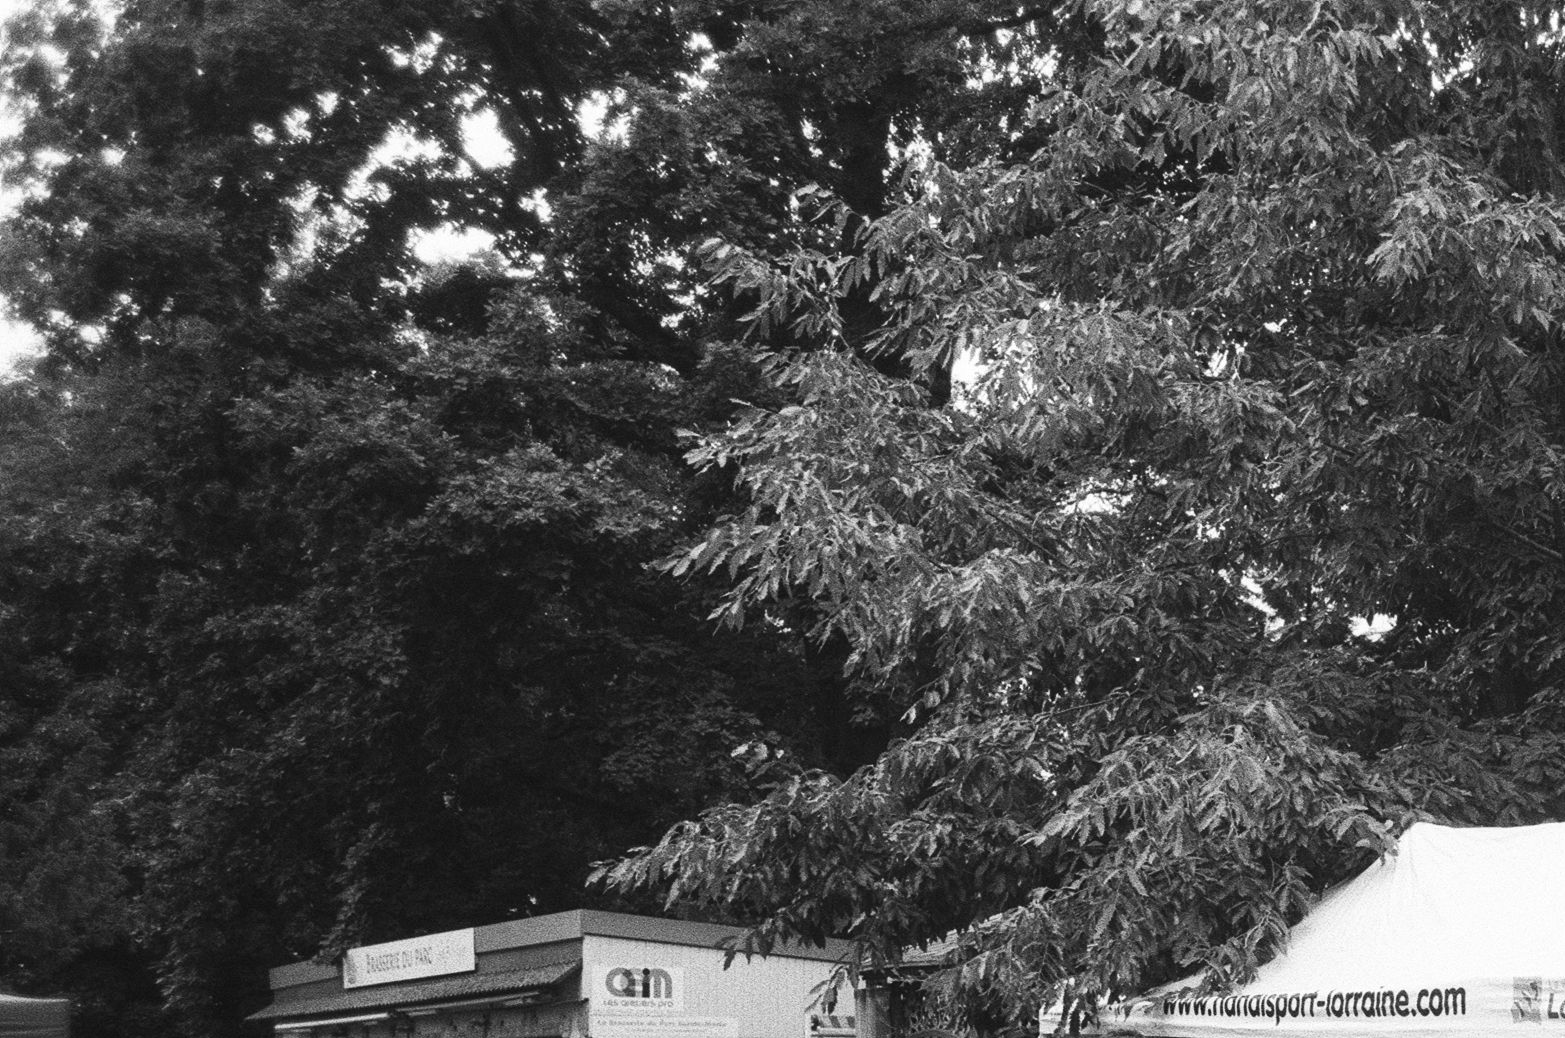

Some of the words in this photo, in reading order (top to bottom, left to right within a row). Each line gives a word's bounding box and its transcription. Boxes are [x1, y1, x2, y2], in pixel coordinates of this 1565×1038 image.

[366, 952, 400, 974] BRASSERIE
[401, 951, 413, 969] DU
[414, 946, 432, 967] PARC
